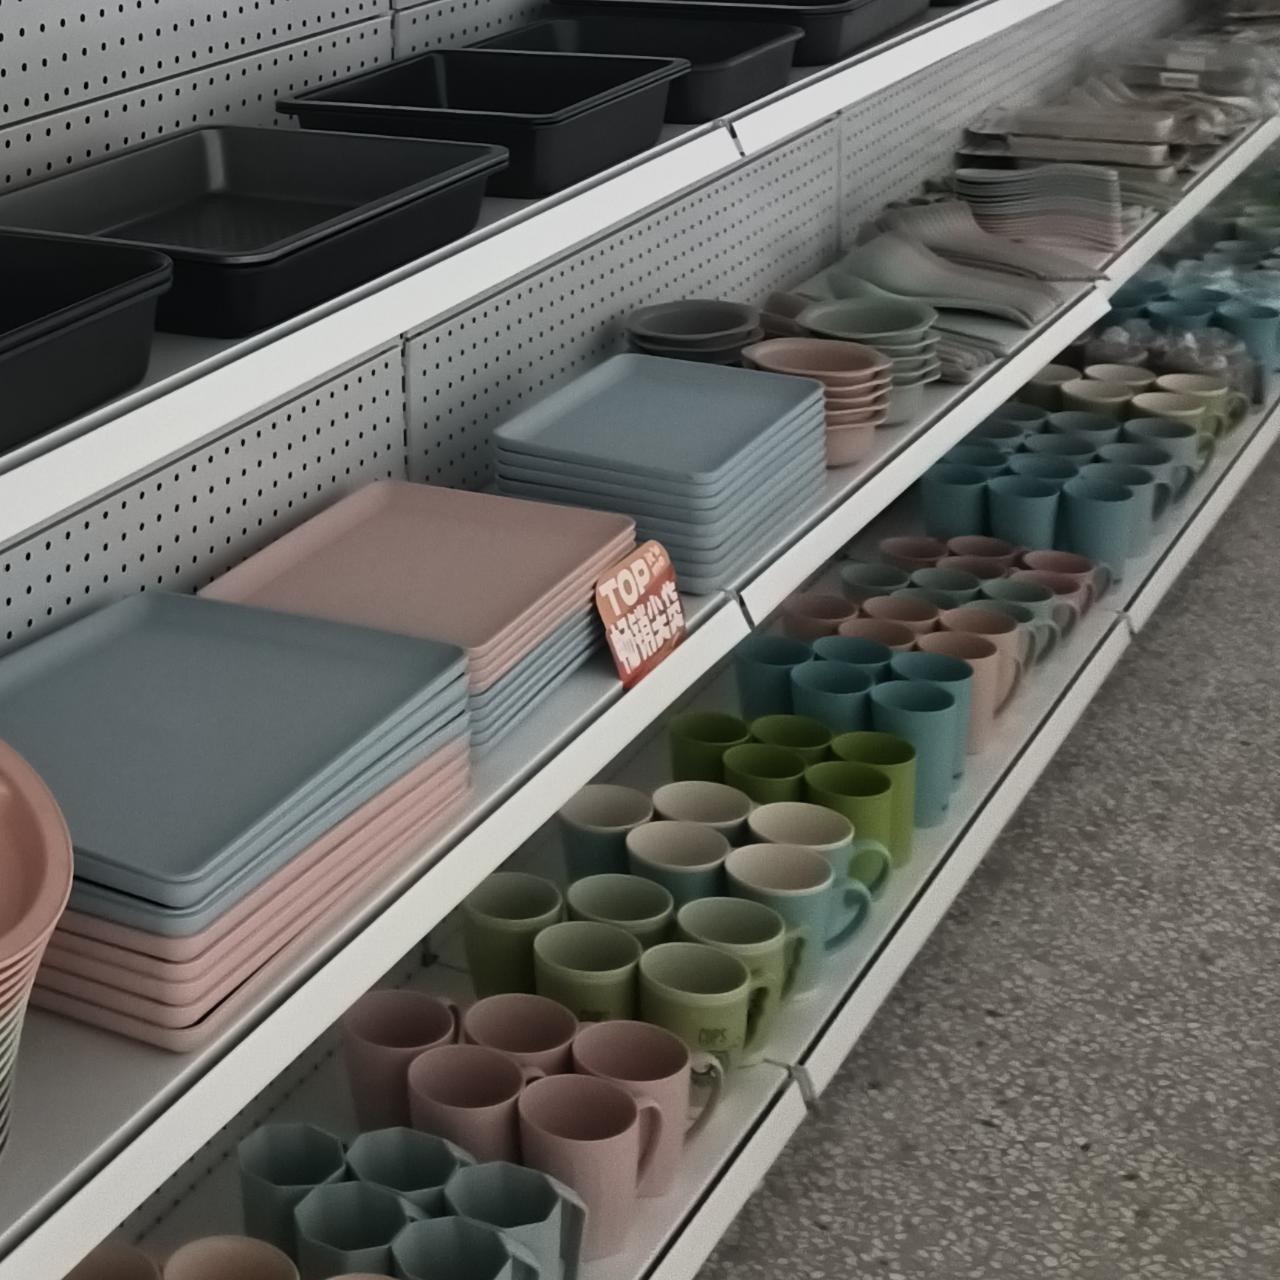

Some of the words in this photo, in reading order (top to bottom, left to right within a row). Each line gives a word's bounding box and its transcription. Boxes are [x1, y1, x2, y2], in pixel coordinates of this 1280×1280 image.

[598, 558, 651, 616] TOP
[609, 580, 684, 675] 畅销尖货
